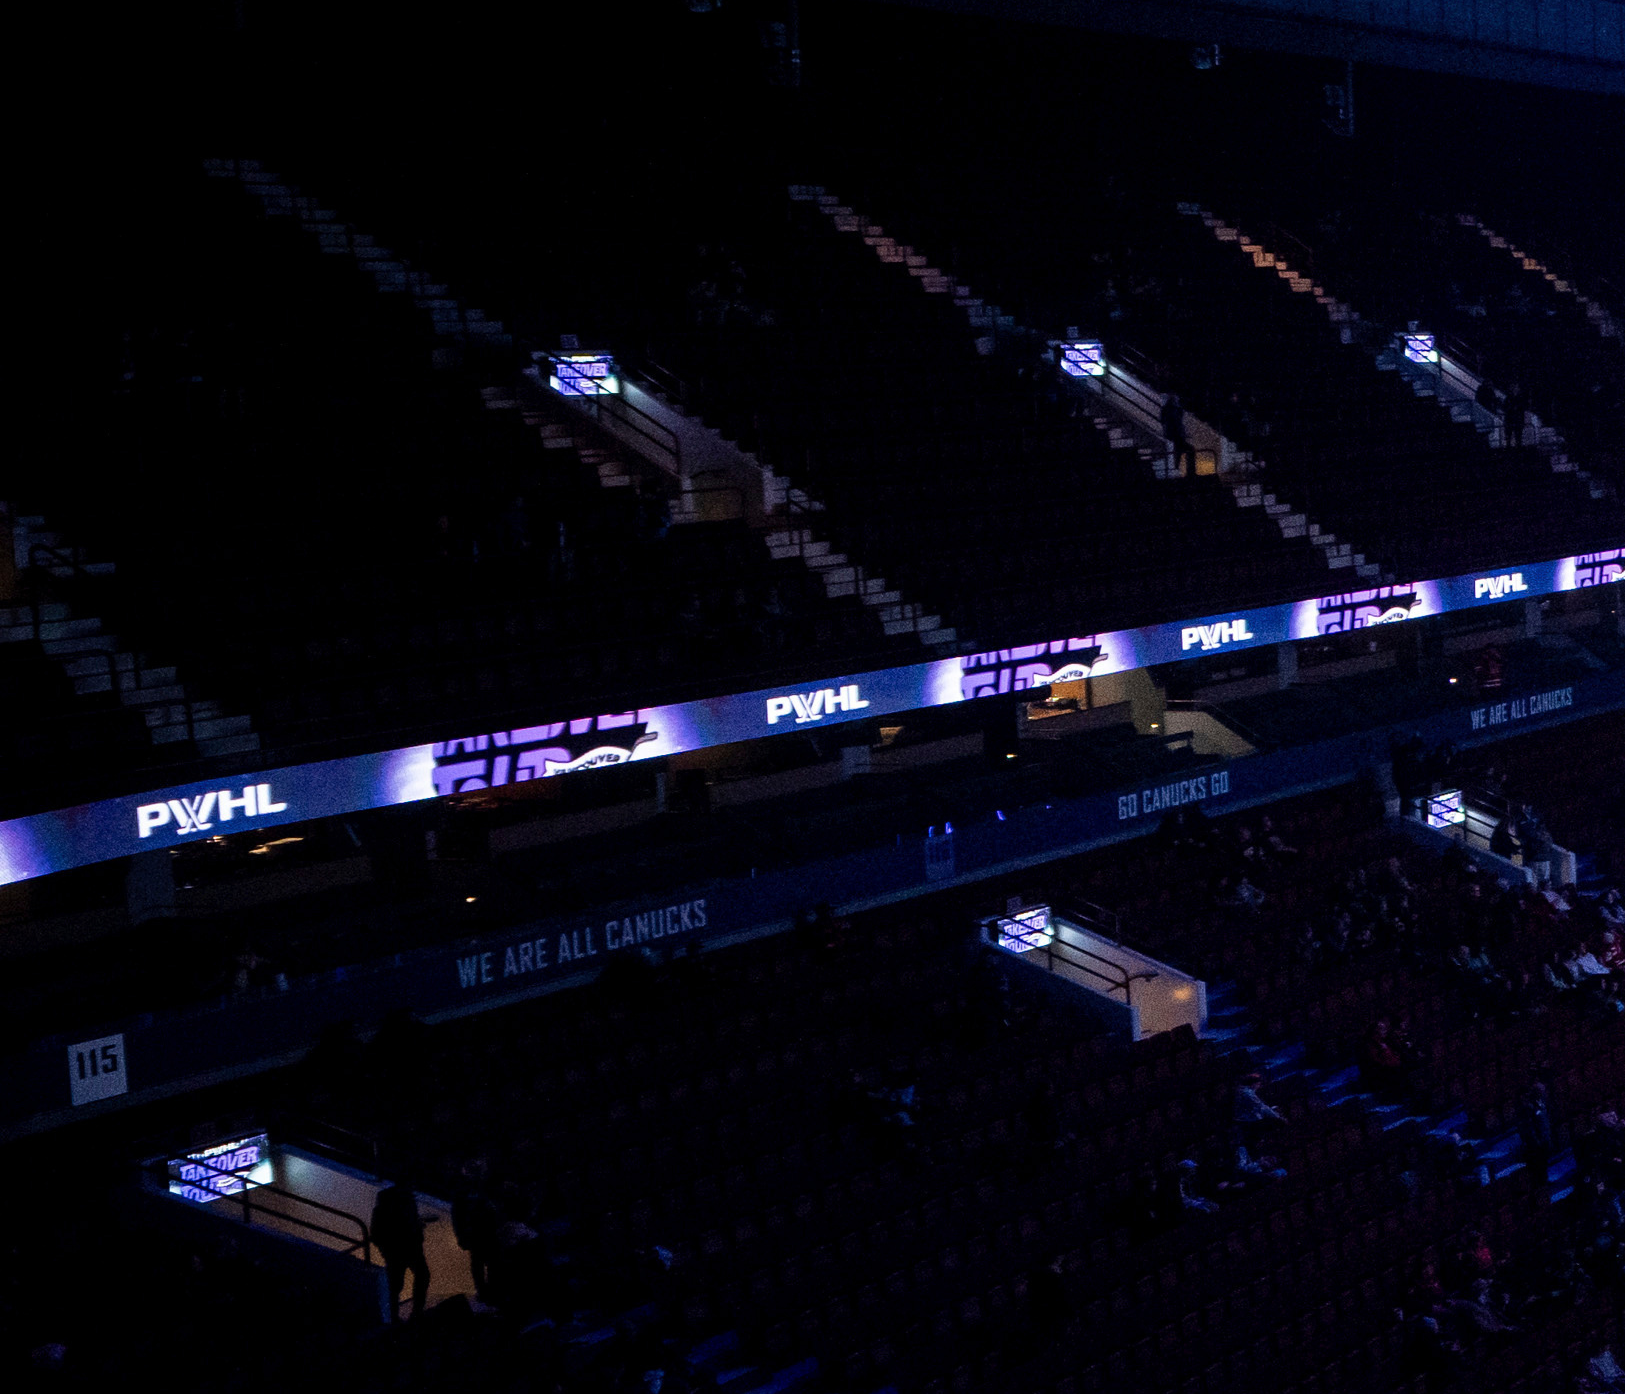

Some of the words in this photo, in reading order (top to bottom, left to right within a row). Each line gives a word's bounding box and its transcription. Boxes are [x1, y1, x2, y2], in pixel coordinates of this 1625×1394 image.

[1474, 571, 1528, 599] PWHL
[1181, 618, 1254, 651] PWHL
[766, 684, 870, 726] PWHL
[1470, 708, 1487, 730] WE
[1488, 702, 1508, 725] ARE
[1509, 698, 1528, 721] ALL
[1529, 686, 1573, 716] CANUCKS
[136, 783, 287, 838] PWHL
[1117, 793, 1138, 820] GO
[1142, 775, 1207, 813] CANUCKS
[1210, 770, 1230, 796] GO
[456, 951, 494, 988] WE
[503, 937, 549, 978] ARE
[557, 926, 598, 964] ALL
[604, 899, 708, 950] CANUCKS
[79, 1045, 118, 1080] 115
